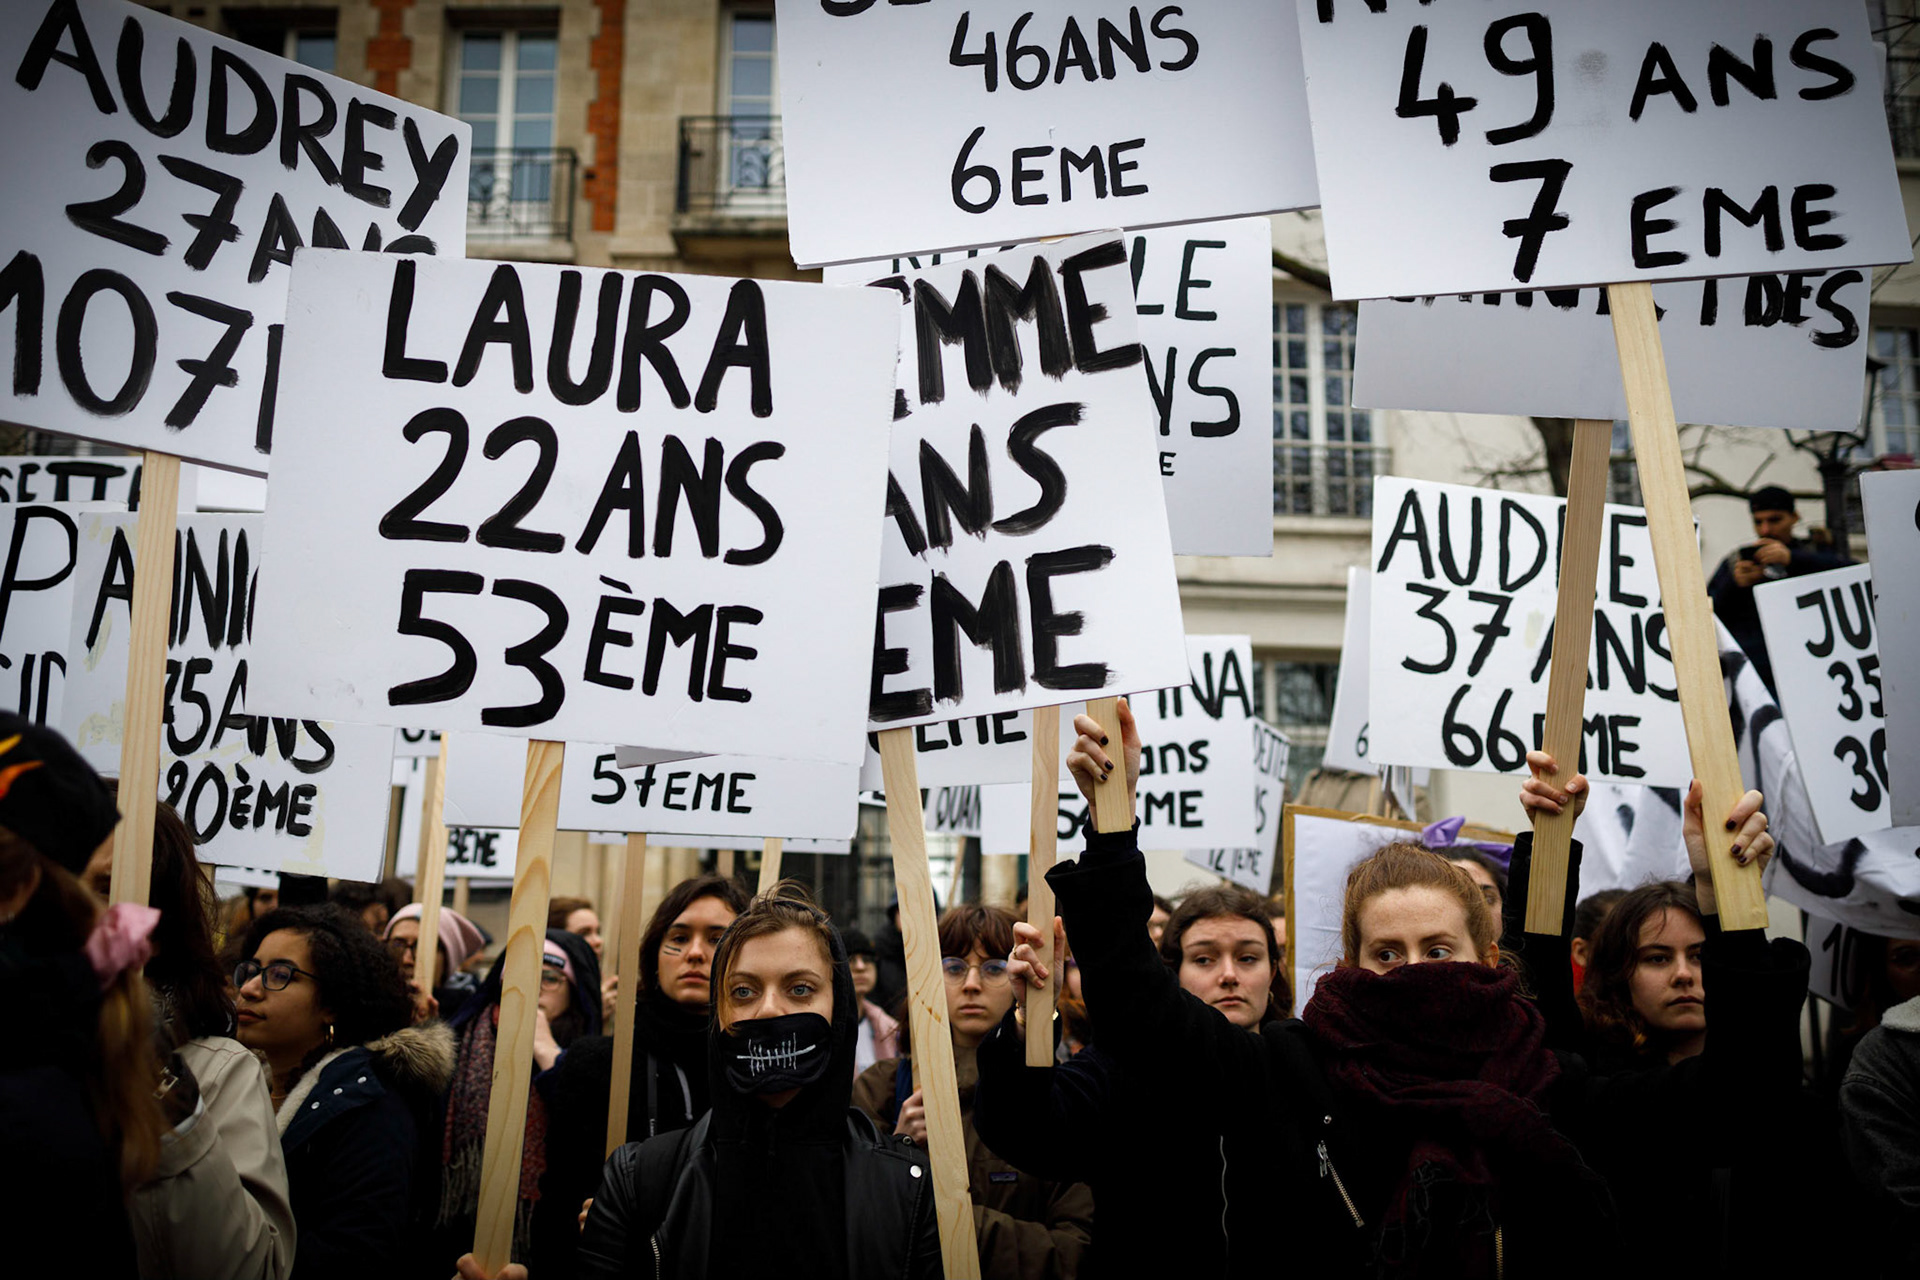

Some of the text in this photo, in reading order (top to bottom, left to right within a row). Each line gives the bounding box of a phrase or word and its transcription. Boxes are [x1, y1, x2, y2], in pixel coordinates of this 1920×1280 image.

[15, 0, 459, 232] AUDREY
[1396, 12, 1858, 146] 49 ANS
[1489, 159, 1849, 283] 7 EME
[382, 258, 772, 418] LAURA
[866, 240, 1143, 420] MME
[1377, 489, 1699, 608] AUDE
[1401, 583, 1514, 676] 37
[1796, 580, 1877, 658] JU
[868, 711, 1027, 755] EME
